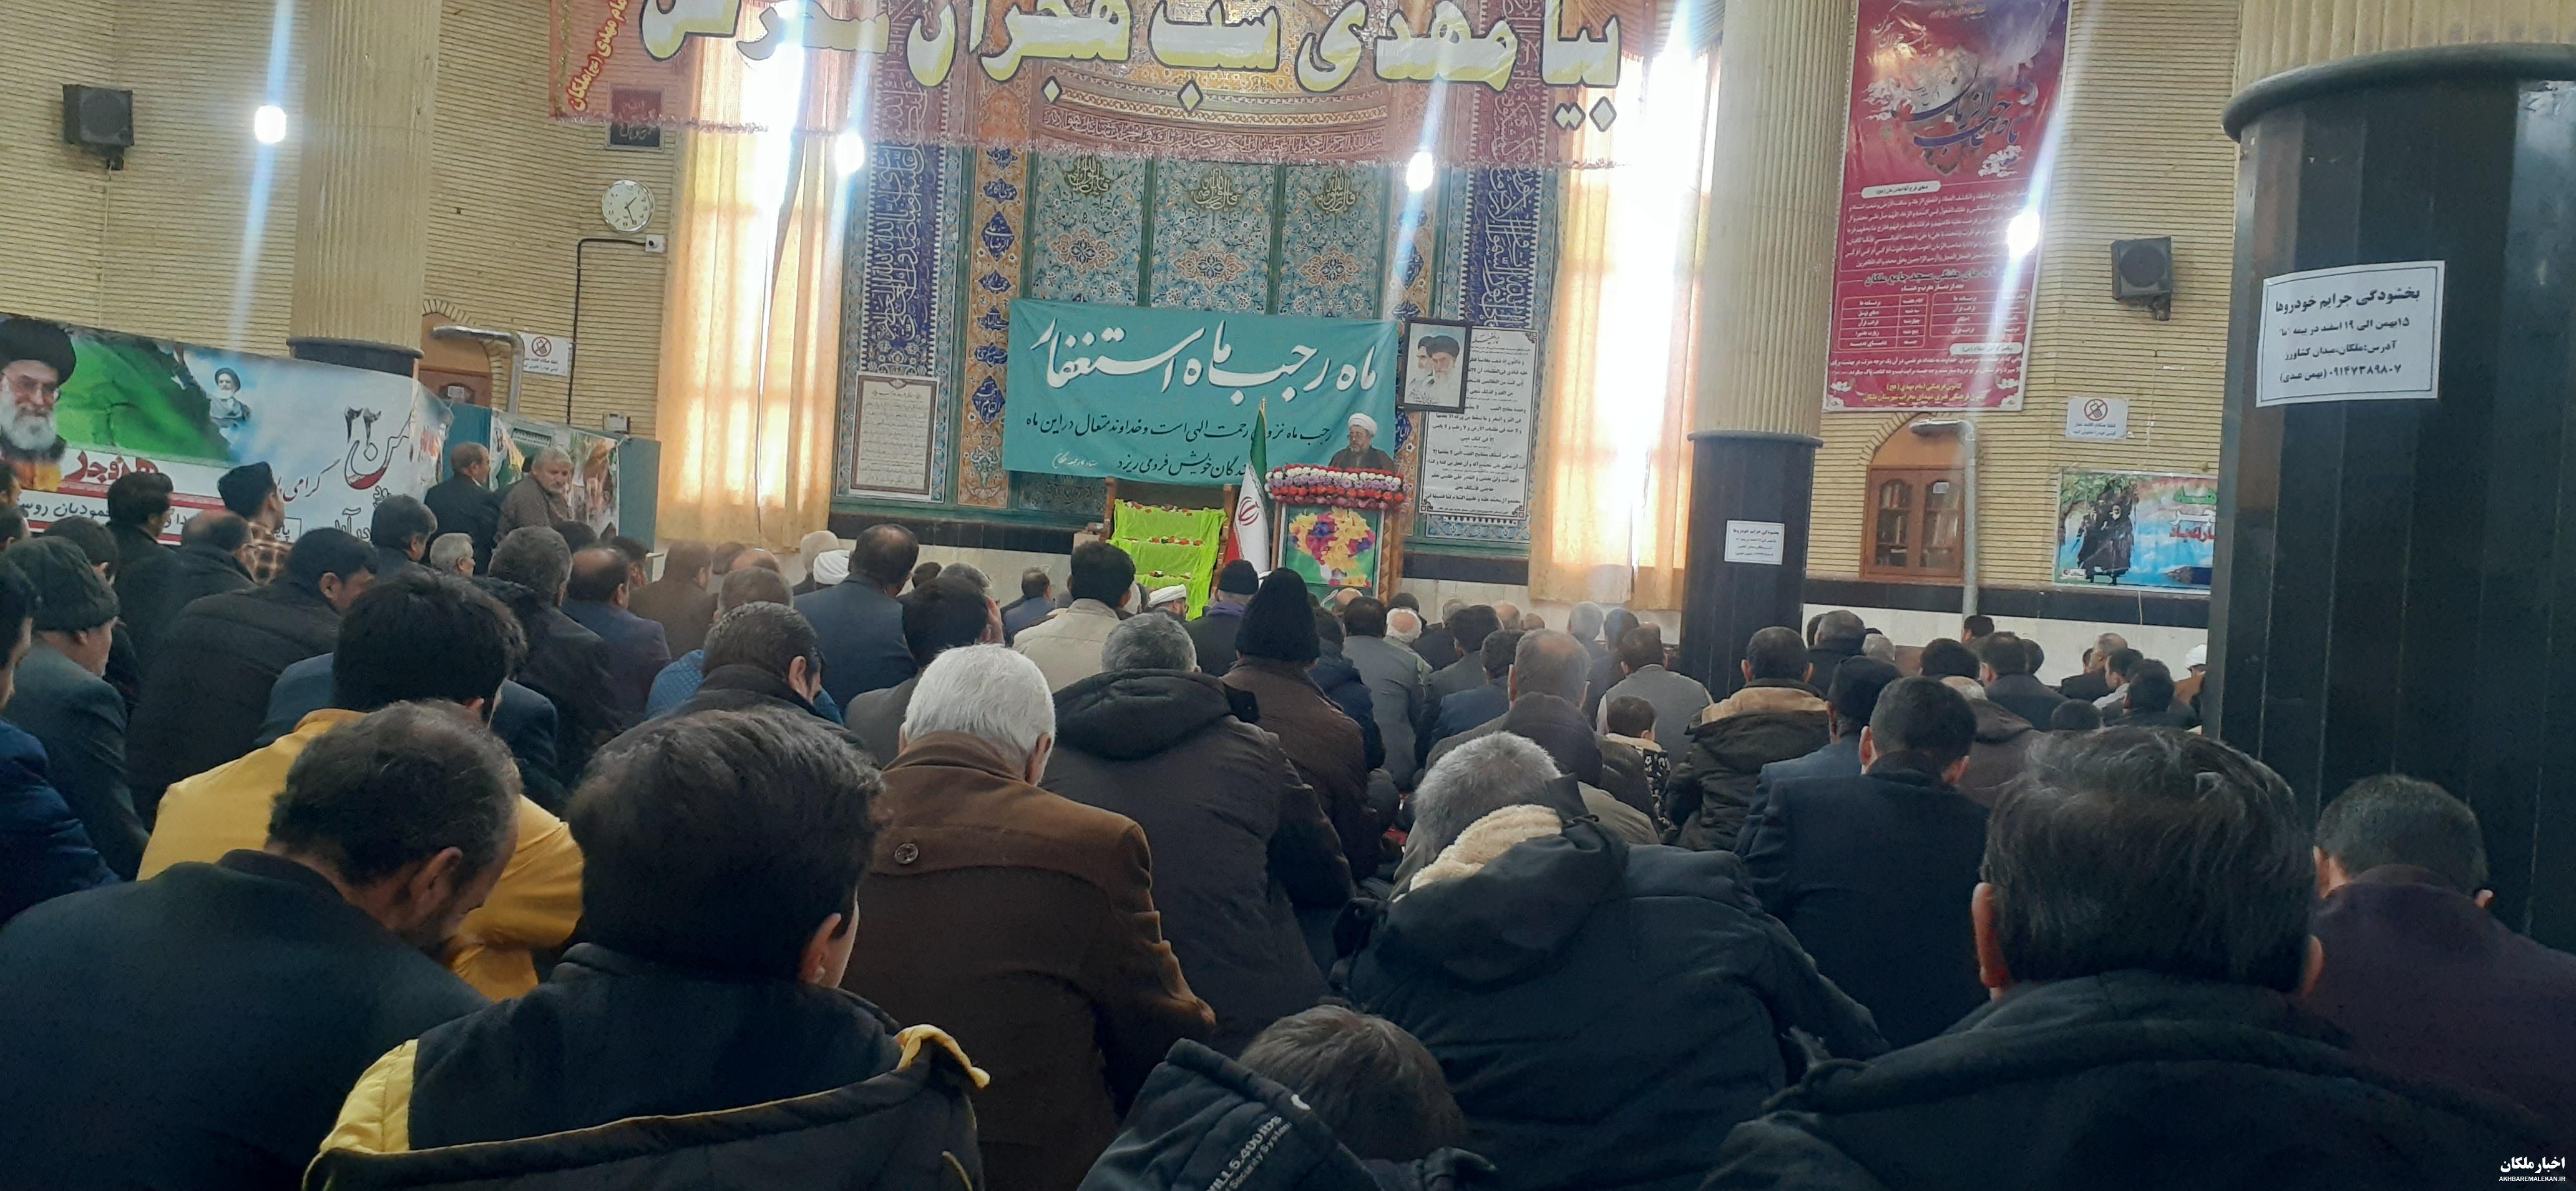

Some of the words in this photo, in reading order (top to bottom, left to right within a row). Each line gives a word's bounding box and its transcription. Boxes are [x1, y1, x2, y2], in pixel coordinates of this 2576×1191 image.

[1295, 0, 1518, 92] مهدی
[2275, 295, 2316, 315] خودروها
[2320, 292, 2352, 310] جرایم
[2356, 287, 2421, 306] بخشودگی
[2310, 326, 2320, 336] در
[2356, 319, 2373, 331] الی
[1030, 318, 1204, 393] استغفار
[1183, 320, 1233, 387] ماه
[1208, 343, 1330, 406] رجب
[1337, 346, 1377, 391] ماه
[1026, 411, 1038, 426] ماه
[1040, 414, 1063, 434] این
[1061, 420, 1074, 431] در
[1075, 413, 1110, 436] متعال
[1150, 422, 1188, 435] است
[1186, 419, 1209, 442] الهی
[1204, 423, 1248, 438] رحمت
[1286, 426, 1297, 439] ماه
[1300, 428, 1332, 446] رجب
[1118, 454, 1138, 473] ریزد
[1168, 451, 1212, 476] خویش
[1211, 455, 1247, 478] ندگان
